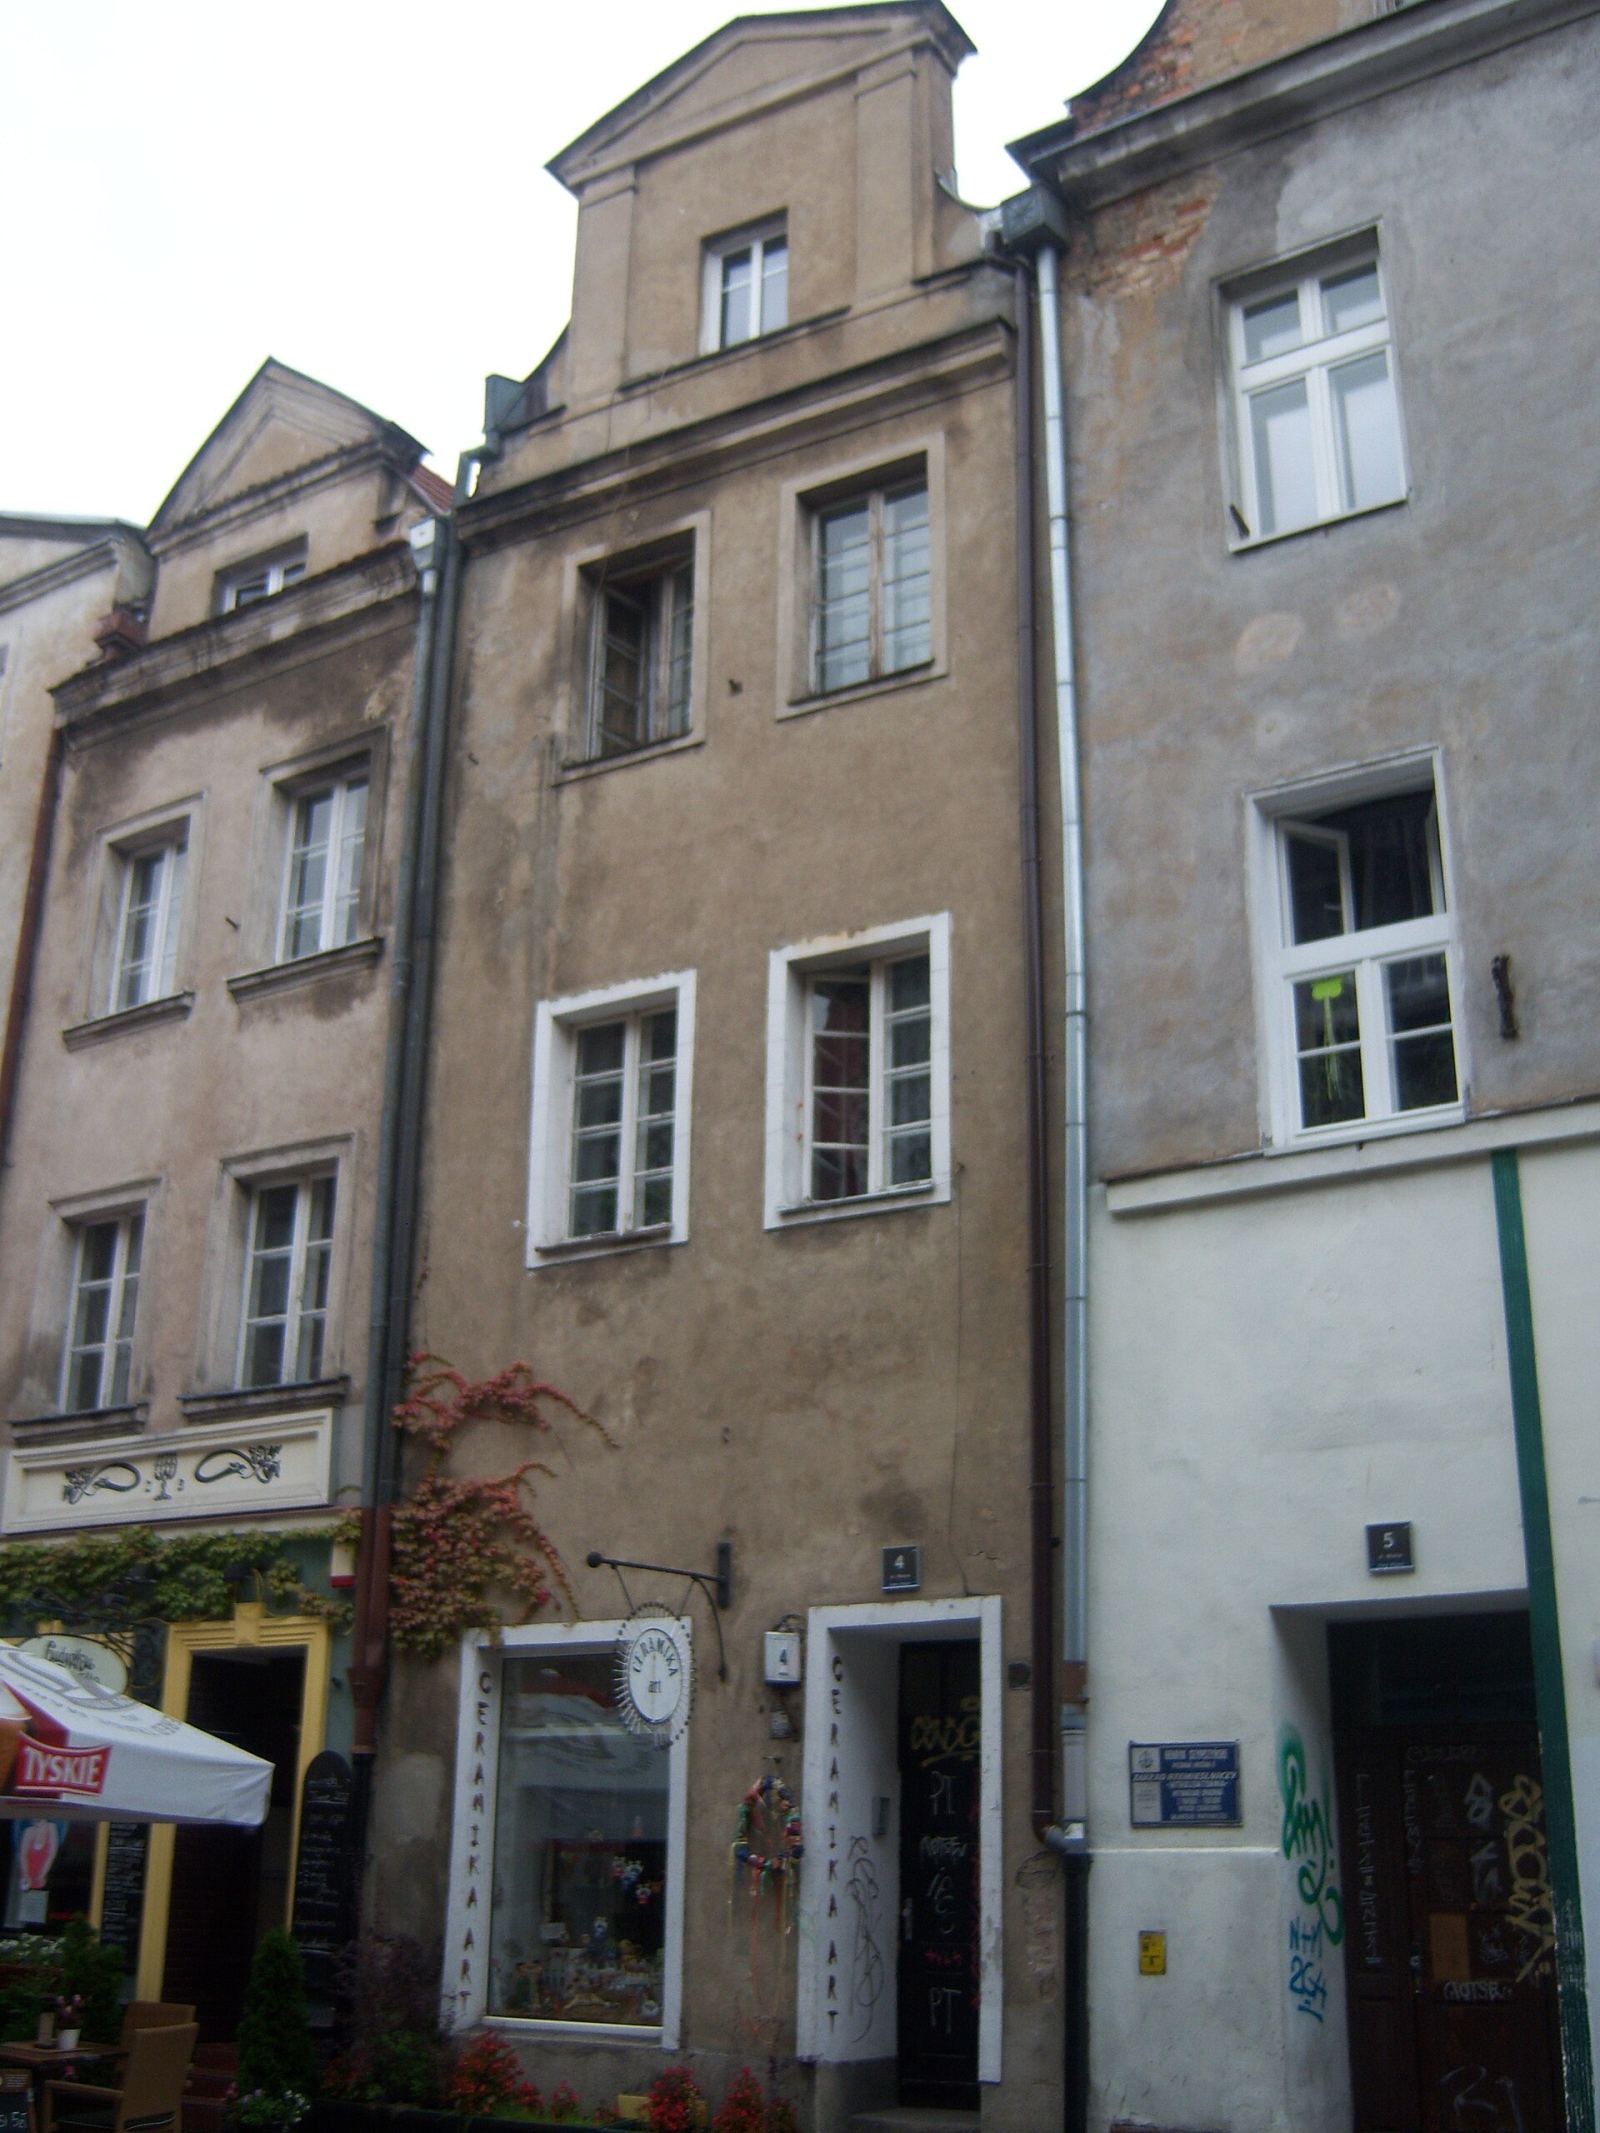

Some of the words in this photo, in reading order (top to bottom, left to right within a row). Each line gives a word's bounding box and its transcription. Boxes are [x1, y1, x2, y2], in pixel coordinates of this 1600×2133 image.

[1383, 1532, 1394, 1548] 5
[895, 1555, 905, 1569] 4
[779, 1649, 788, 1666] 4
[648, 1680, 662, 1693] art
[24, 1745, 102, 1786] TYSKIE
[466, 1671, 492, 1909] CERAMIKA
[828, 1655, 843, 1919] CERAMIKA
[459, 1927, 475, 2012] ART
[827, 1939, 839, 2034] ART
